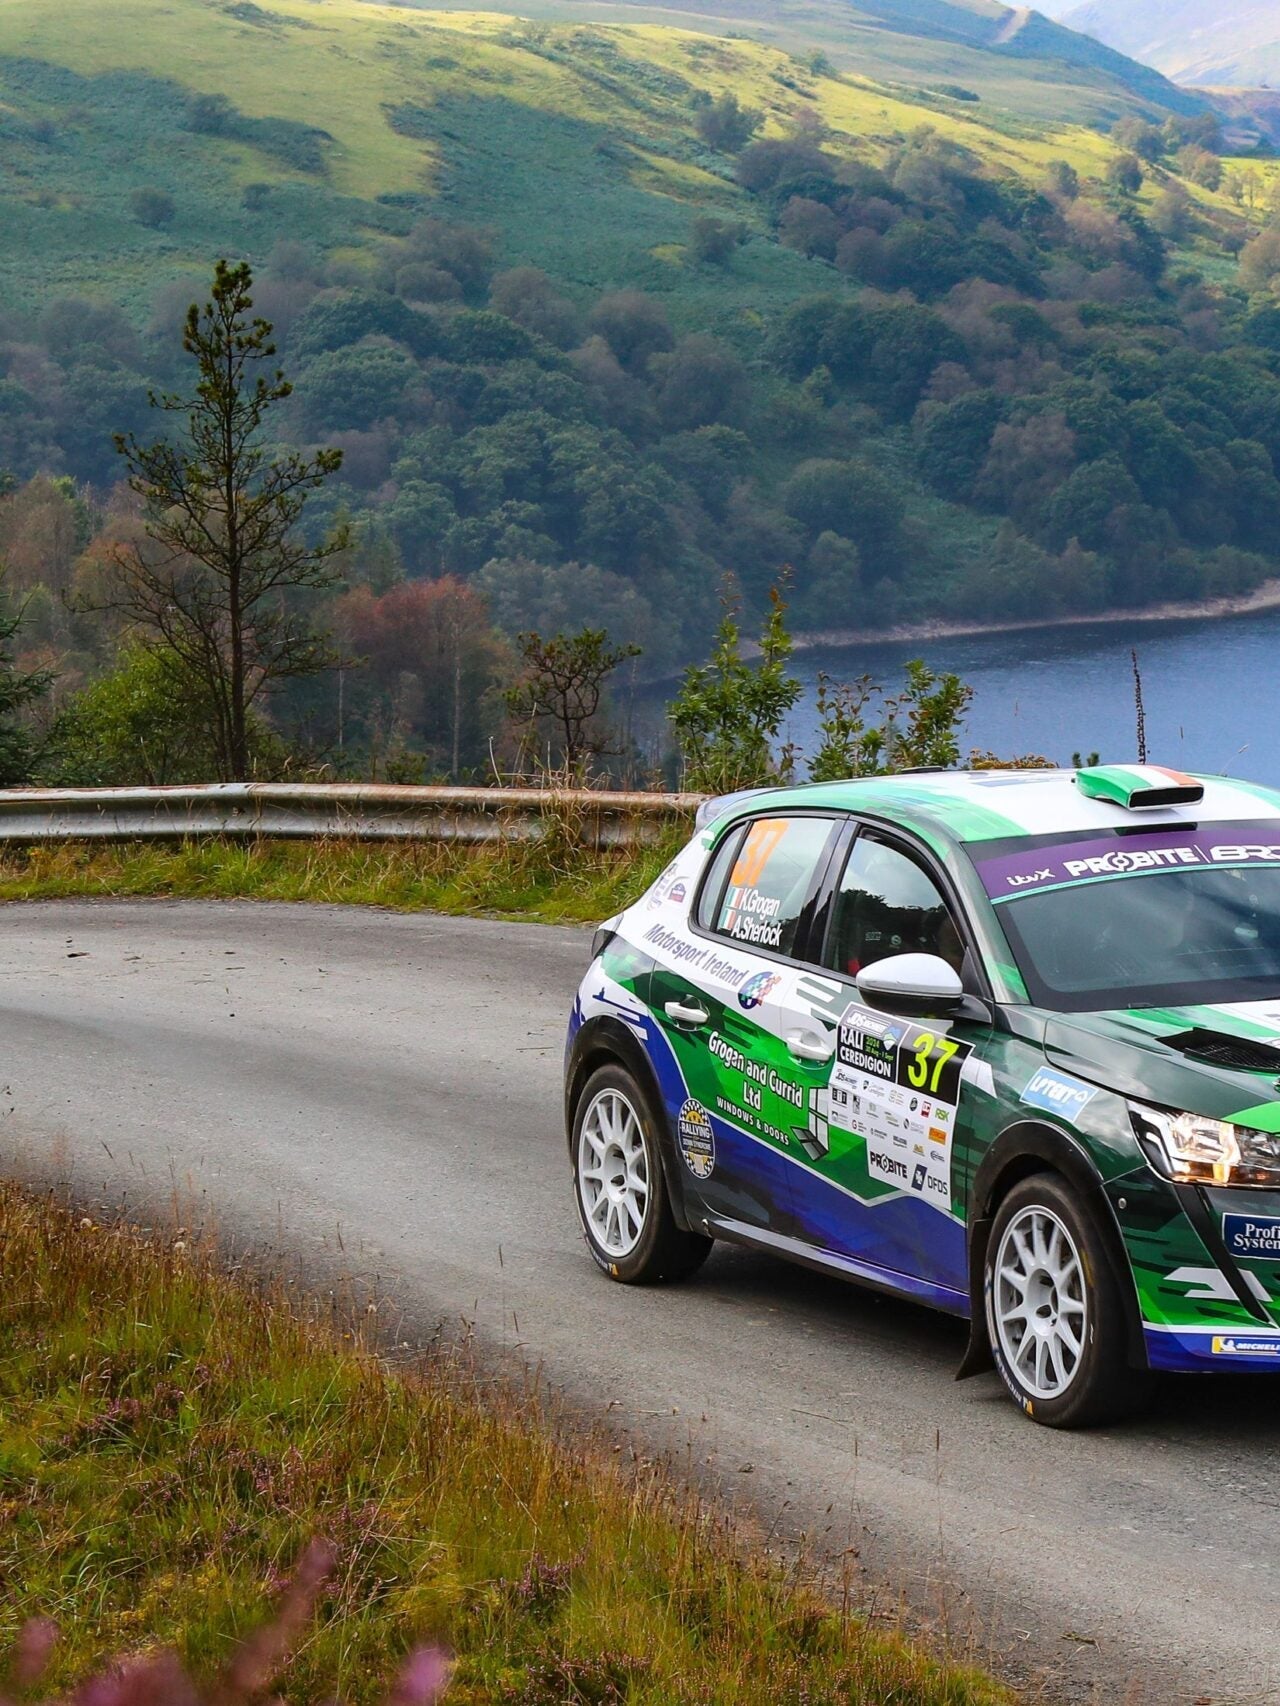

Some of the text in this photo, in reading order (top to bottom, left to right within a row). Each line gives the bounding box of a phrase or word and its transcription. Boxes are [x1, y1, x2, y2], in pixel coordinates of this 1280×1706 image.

[1006, 868, 1056, 886] itvX
[1063, 847, 1200, 877] PROBITE
[731, 915, 783, 946] A.Sherlock
[642, 923, 749, 986] Motorsport Ireland
[840, 1025, 864, 1050] RALI
[708, 1031, 746, 1072] Grogan
[746, 1059, 767, 1086] and
[768, 1070, 804, 1109] Currid
[840, 1047, 891, 1078] CEREDIGION
[908, 1032, 960, 1093] 37
[743, 1081, 762, 1110] Ltd
[681, 1122, 710, 1138] RALLYING
[716, 1096, 790, 1146] WINDOWS & DOORS
[870, 1151, 908, 1179] PROBITE
[927, 1175, 948, 1195] DFDS
